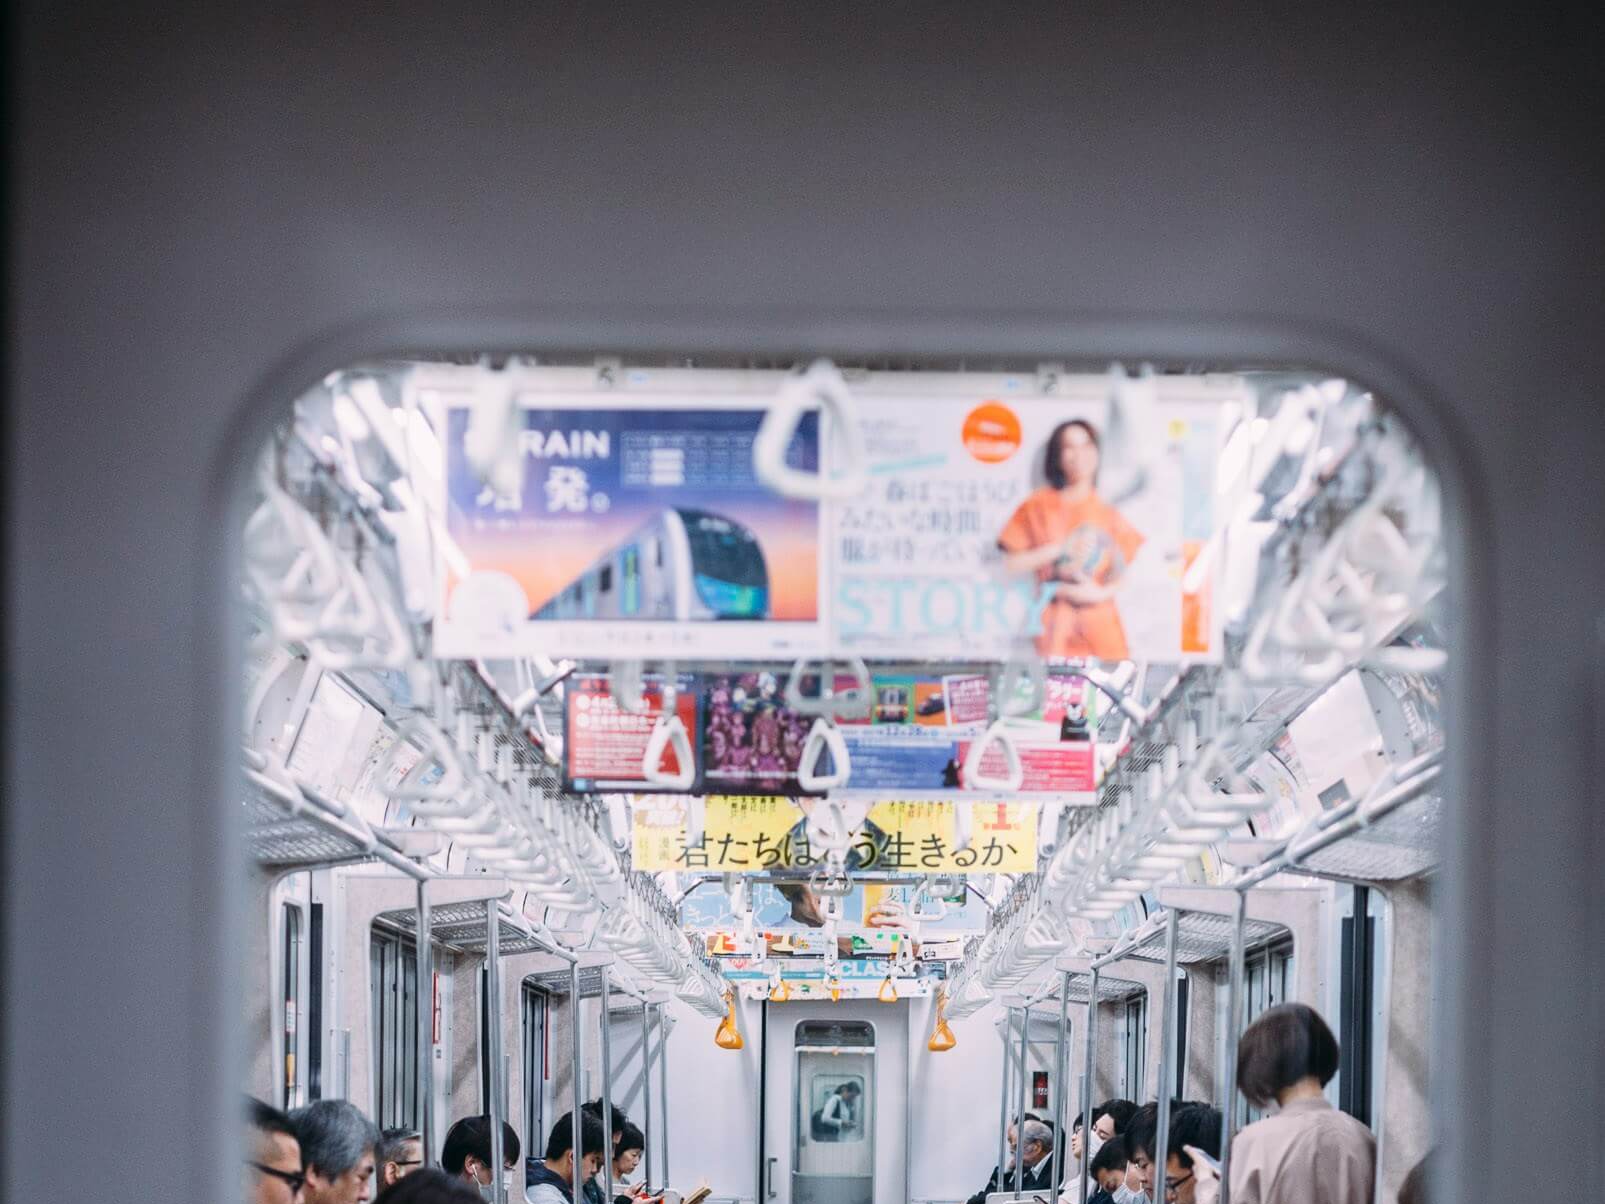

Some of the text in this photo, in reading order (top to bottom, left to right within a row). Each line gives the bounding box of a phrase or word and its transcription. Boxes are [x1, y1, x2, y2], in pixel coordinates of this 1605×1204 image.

[521, 430, 611, 460] RAIN
[838, 577, 1058, 638] STORY
[675, 829, 1018, 869] 君たちはう生きるか
